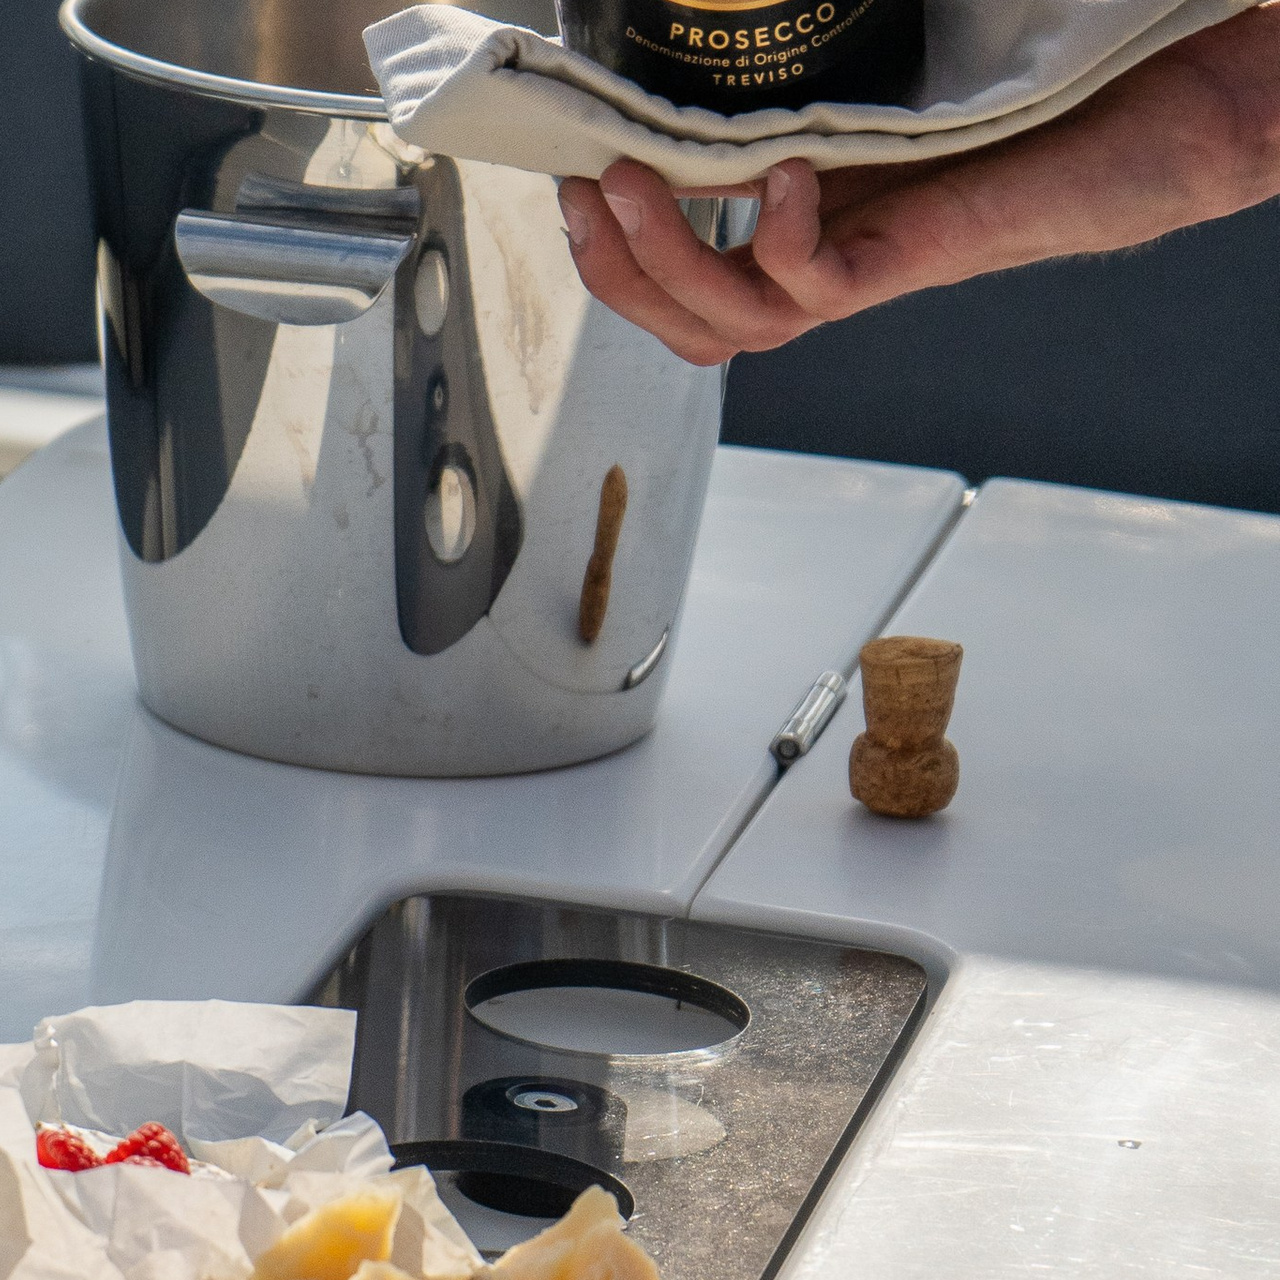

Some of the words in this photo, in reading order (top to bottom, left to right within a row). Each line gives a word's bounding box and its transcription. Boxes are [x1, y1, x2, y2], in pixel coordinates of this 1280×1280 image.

[625, 26, 730, 68] Denominazione
[735, 55, 749, 67] di
[754, 44, 808, 65] Origine
[669, 2, 835, 50] PROSECCO
[712, 63, 804, 86] TREVISO
